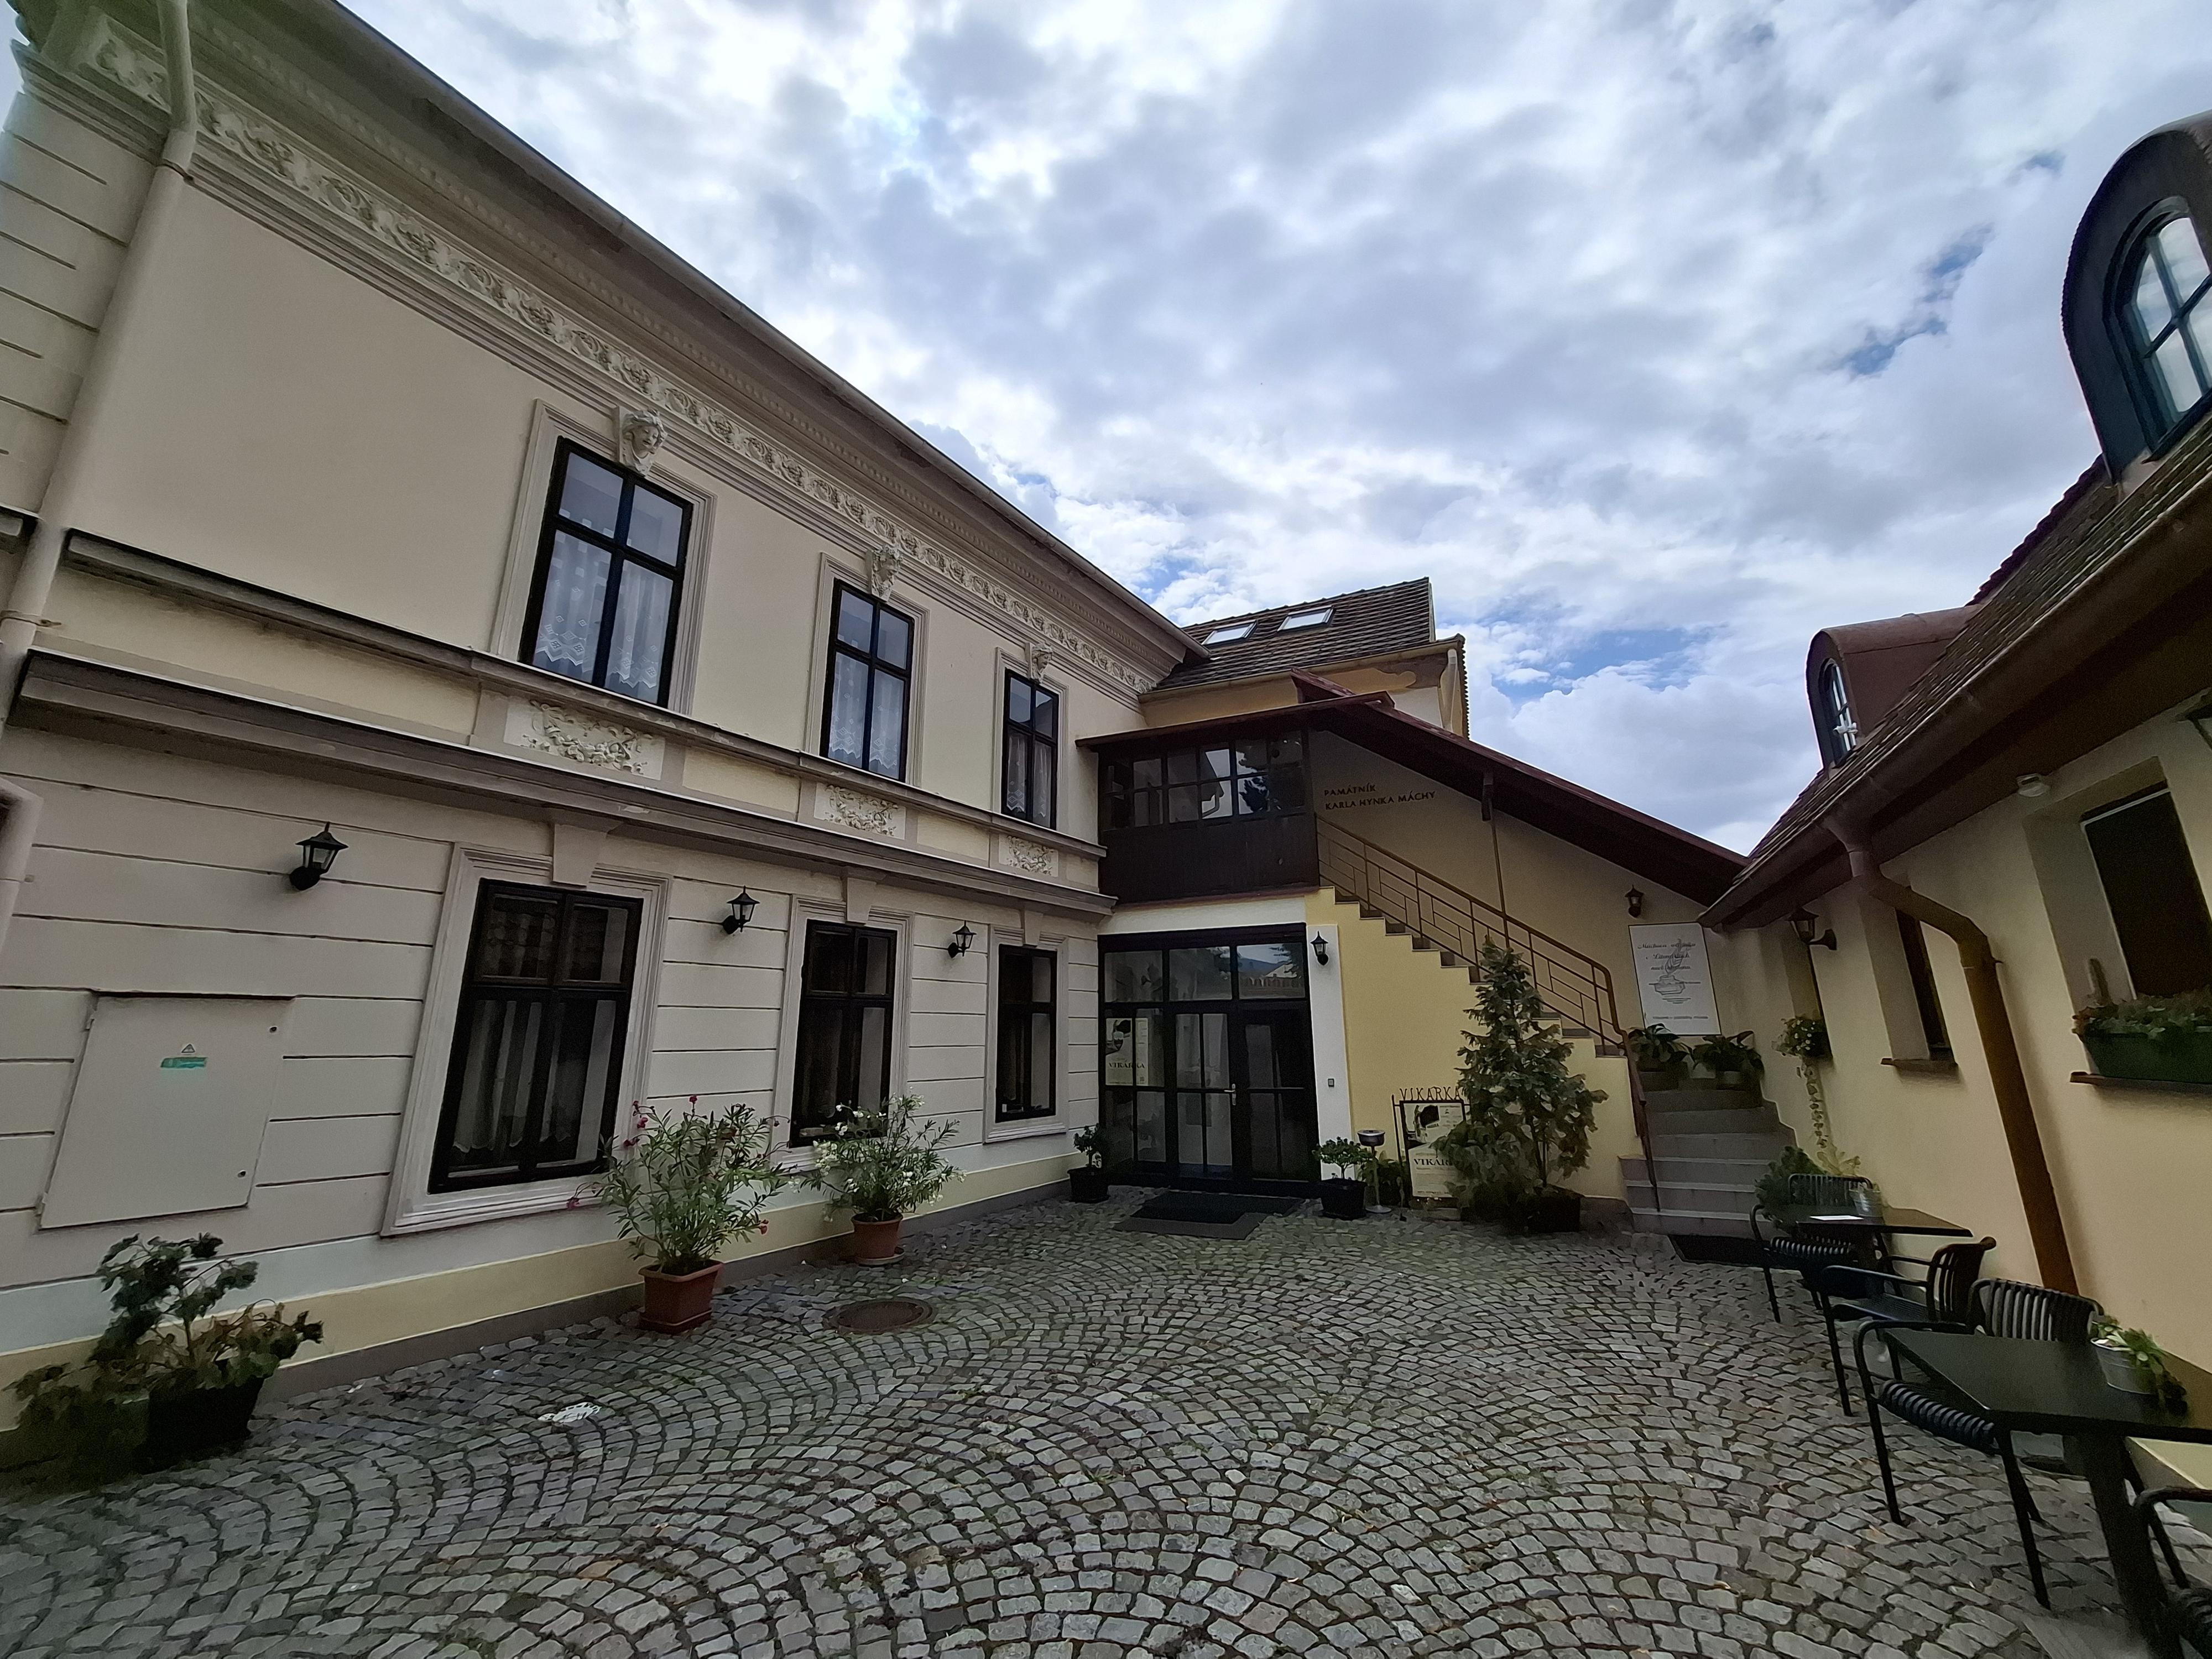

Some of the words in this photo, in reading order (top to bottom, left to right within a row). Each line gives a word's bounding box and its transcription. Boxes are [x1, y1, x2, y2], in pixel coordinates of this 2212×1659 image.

[1324, 782, 1376, 796] PAMÁTNÍK
[1326, 801, 1356, 810] KARLA
[1359, 797, 1394, 806] HYNKA
[1398, 791, 1435, 802] MÁCHY
[1413, 1156, 1453, 1166] VIKÁR
